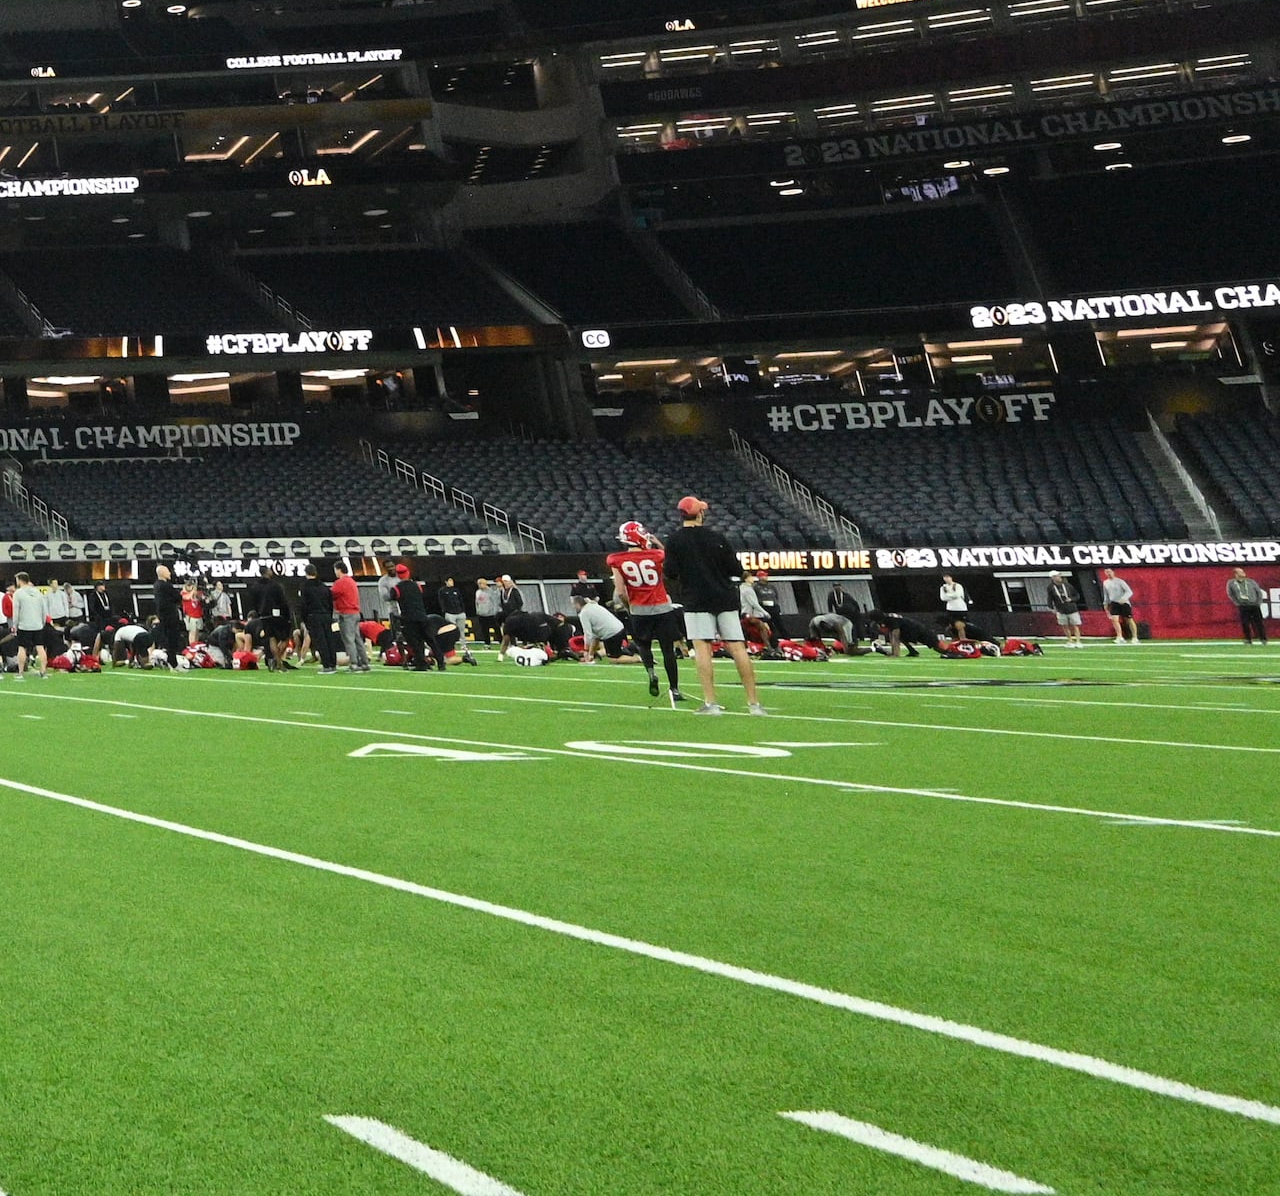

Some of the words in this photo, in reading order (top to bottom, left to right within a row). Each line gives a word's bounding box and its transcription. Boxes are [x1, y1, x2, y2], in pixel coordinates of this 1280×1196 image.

[226, 55, 282, 69] COLLEGE
[282, 52, 347, 66] FOOTBALL
[347, 49, 402, 62] PLAYOFF
[866, 118, 1037, 158] NATIONAL
[1047, 290, 1213, 322] NATIONAL
[206, 330, 373, 354] #CFBPLAYOFF
[767, 393, 1055, 432] #CFBPLAYOFF
[76, 422, 301, 449] CHAMPIONSHIP
[736, 551, 808, 573] ELCOME
[810, 551, 834, 569] TO
[836, 548, 870, 568] THE
[938, 545, 1071, 567] NATIONAL
[1072, 542, 1280, 564] CHAMPIONSHIP
[621, 559, 659, 587] 96
[515, 654, 532, 667] 91
